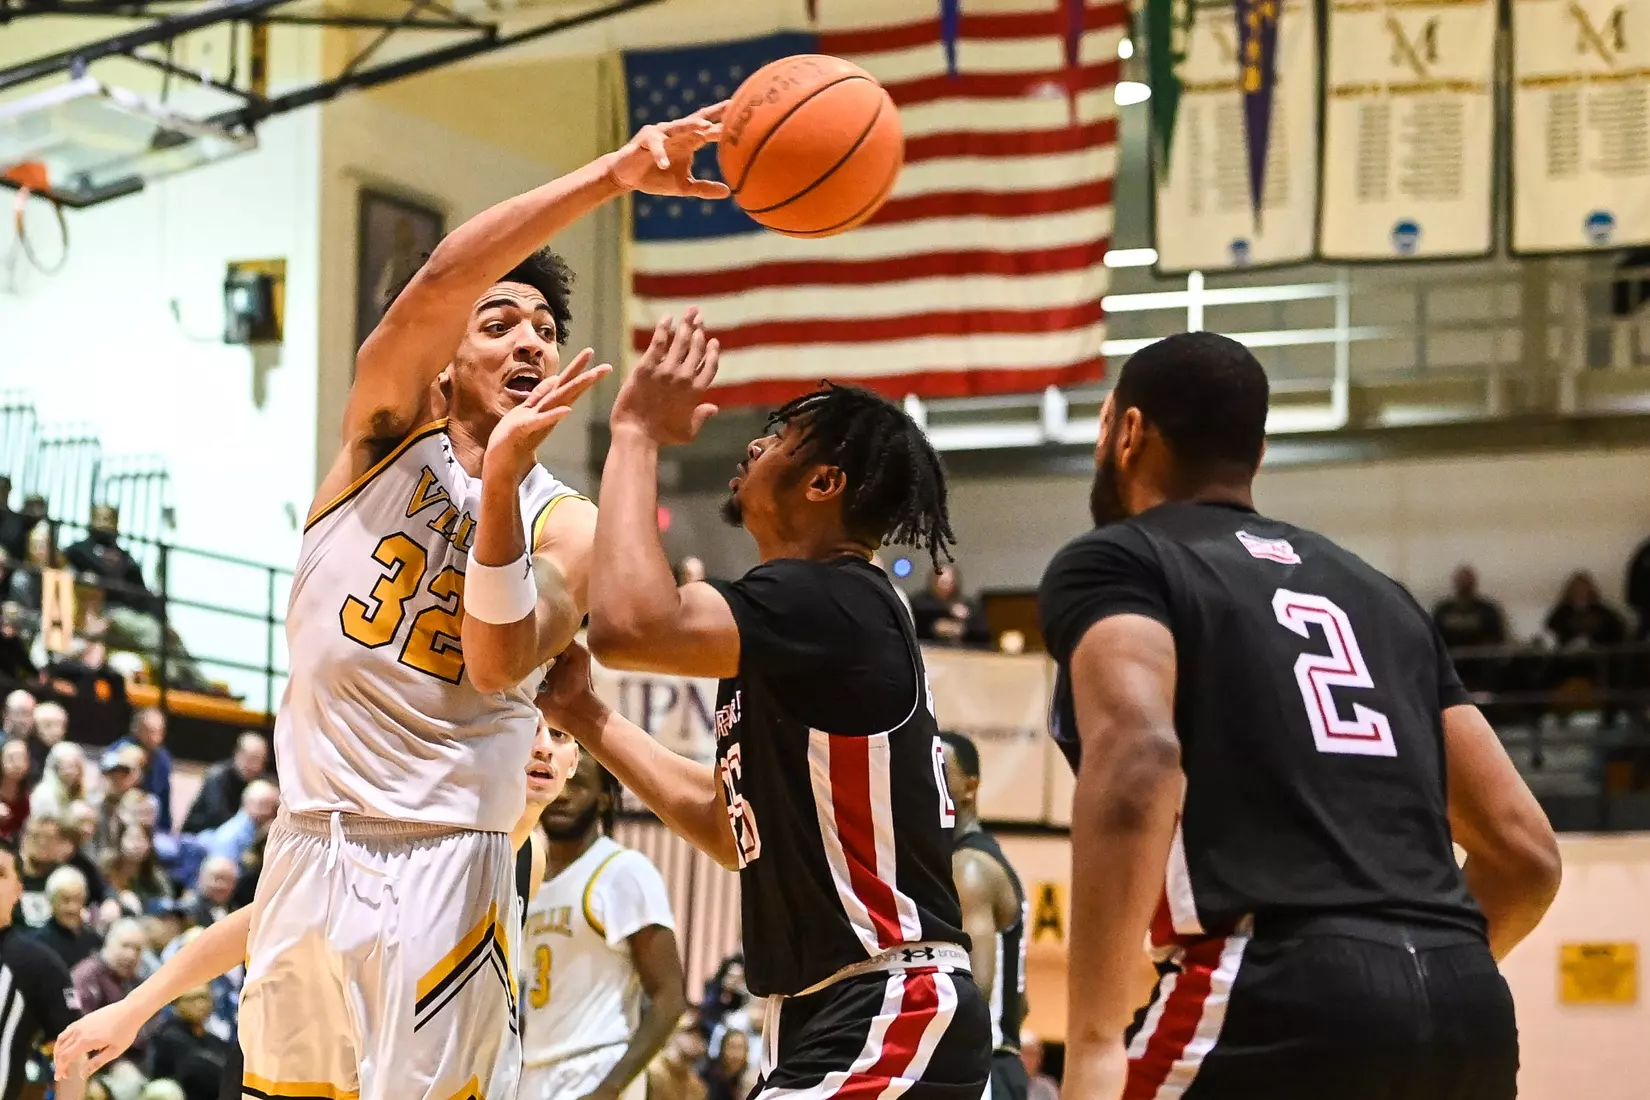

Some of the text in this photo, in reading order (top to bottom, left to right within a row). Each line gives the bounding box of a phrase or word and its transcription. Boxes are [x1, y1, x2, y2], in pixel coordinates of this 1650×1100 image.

[339, 530, 466, 685] 32
[1271, 587, 1398, 757] 2
[529, 943, 553, 1010] 3
